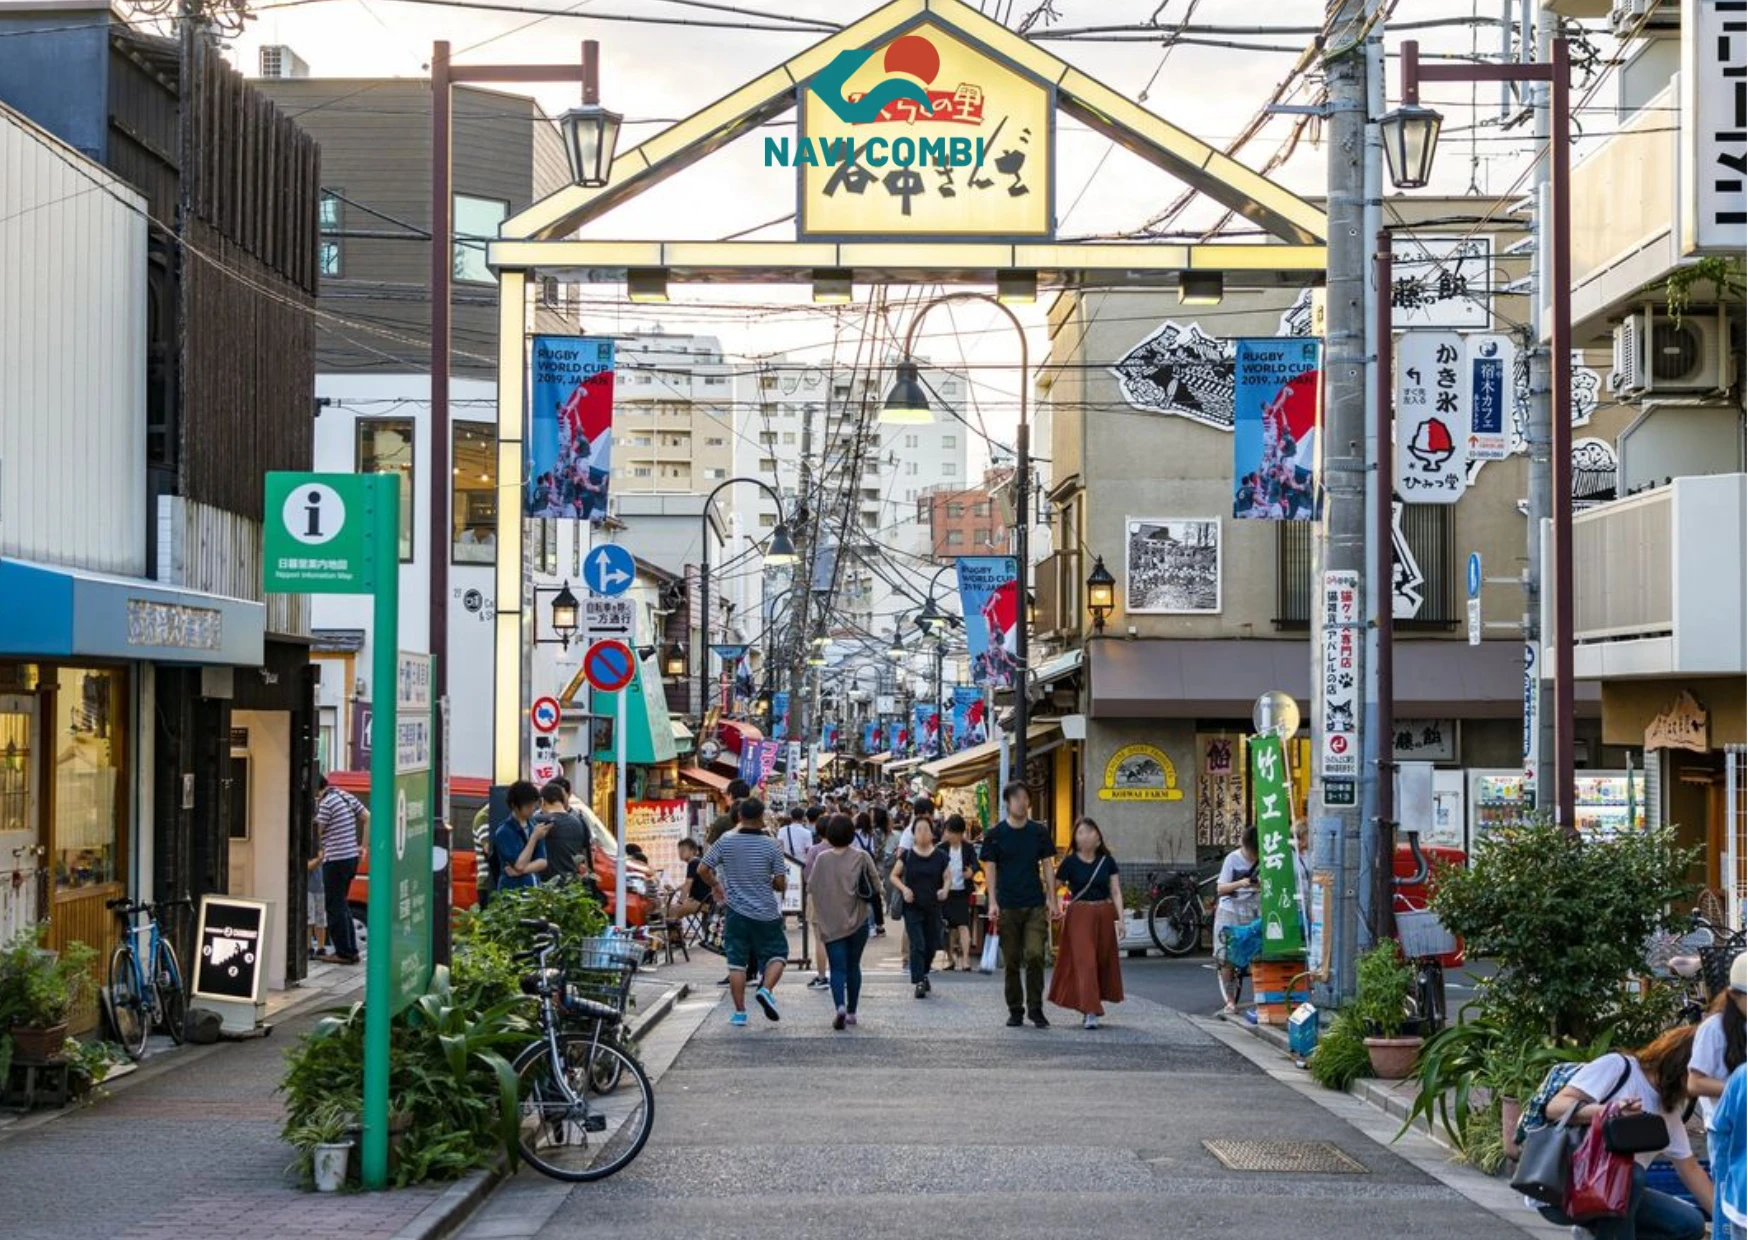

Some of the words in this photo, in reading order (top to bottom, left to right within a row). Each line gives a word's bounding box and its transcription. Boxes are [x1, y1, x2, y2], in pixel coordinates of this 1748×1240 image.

[537, 350, 579, 360] RUGBY
[1241, 352, 1284, 362] RUGBY
[537, 361, 581, 373] WORLD
[583, 363, 609, 373] CUP
[1241, 364, 1286, 373] WORLD
[1288, 364, 1314, 374] CUP
[568, 374, 609, 385] JAPAN
[1272, 375, 1314, 386] JAPAN
[1436, 343, 1458, 413] かき氷
[1480, 364, 1495, 429] 宿木カフェ
[1402, 473, 1459, 490] ひみつ堂
[586, 613, 631, 624] 一方通行
[1326, 590, 1338, 695] 猫雑貨アパレルの店
[1145, 790, 1169, 798] FARM
[1256, 745, 1286, 870] 竹工芸
